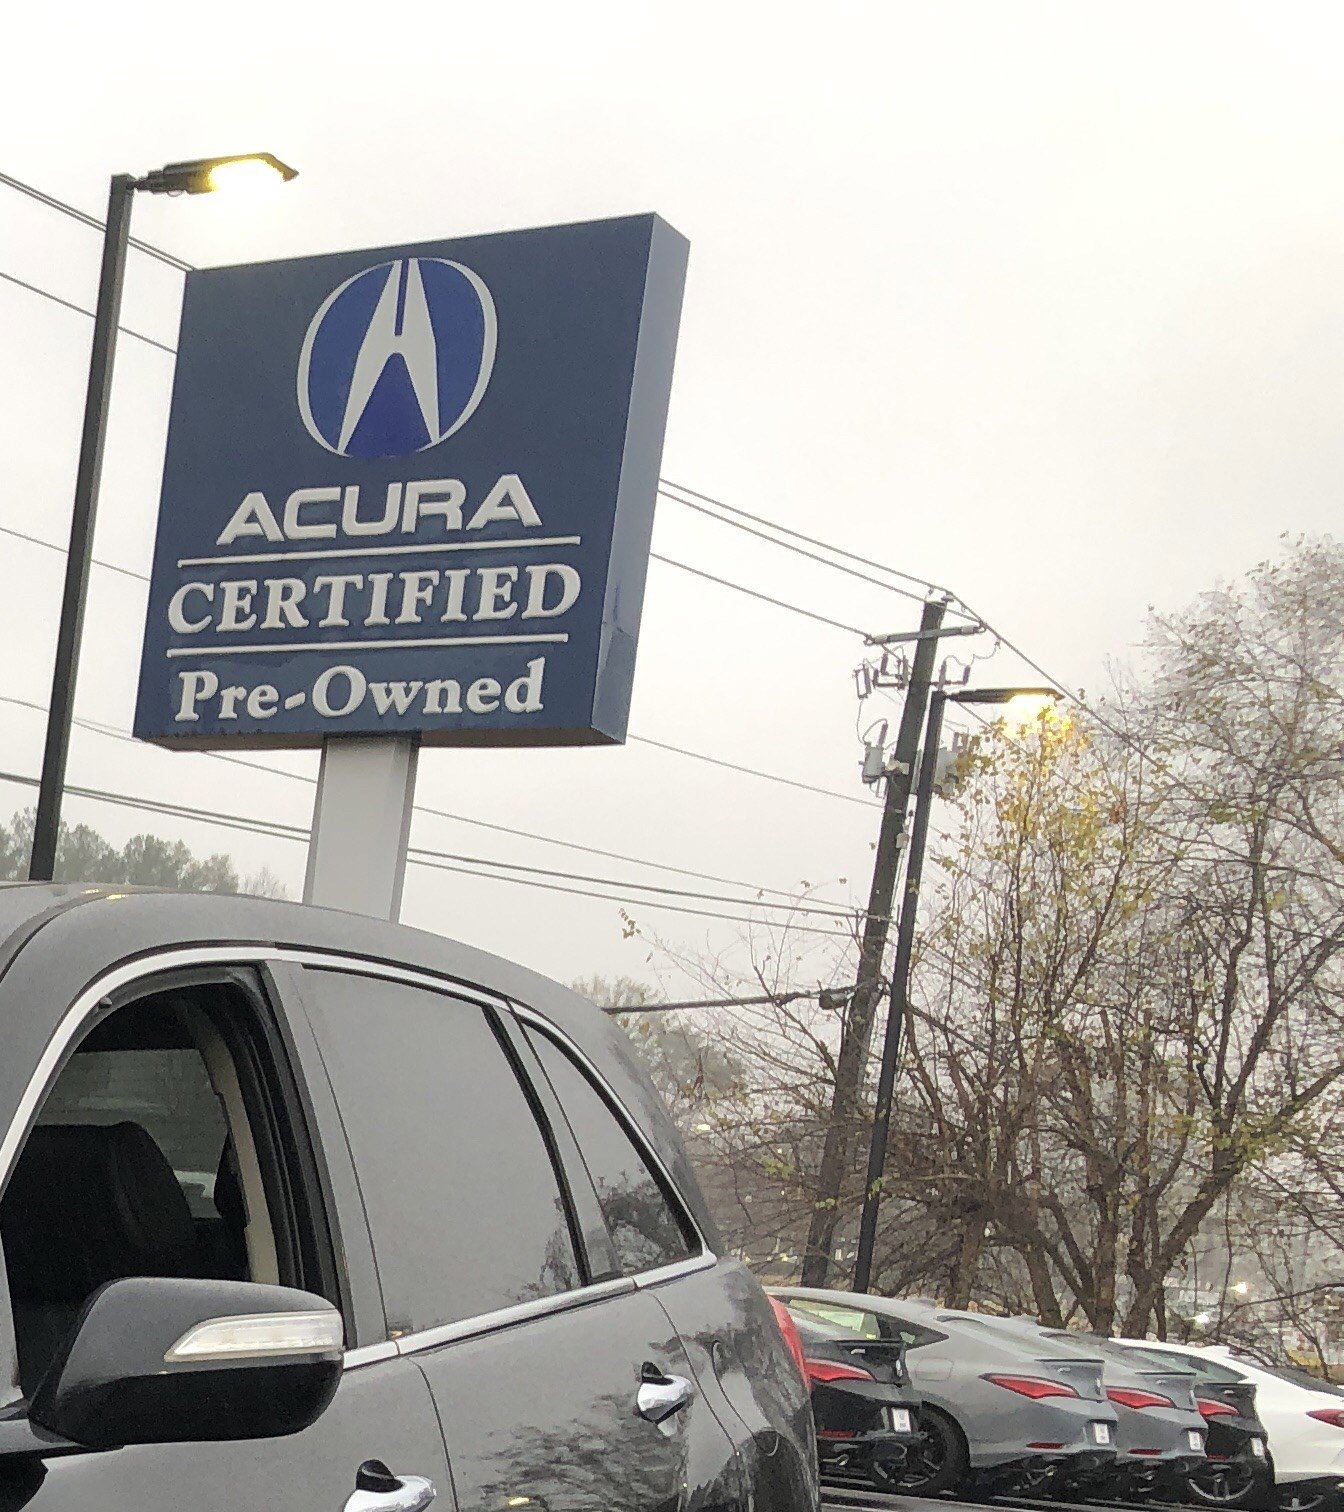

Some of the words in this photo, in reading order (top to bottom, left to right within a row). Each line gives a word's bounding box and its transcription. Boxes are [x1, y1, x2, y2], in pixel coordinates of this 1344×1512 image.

[216, 474, 542, 545] ACURA
[168, 564, 581, 634] CERTIFIED
[174, 658, 545, 722] Pre-Owned
